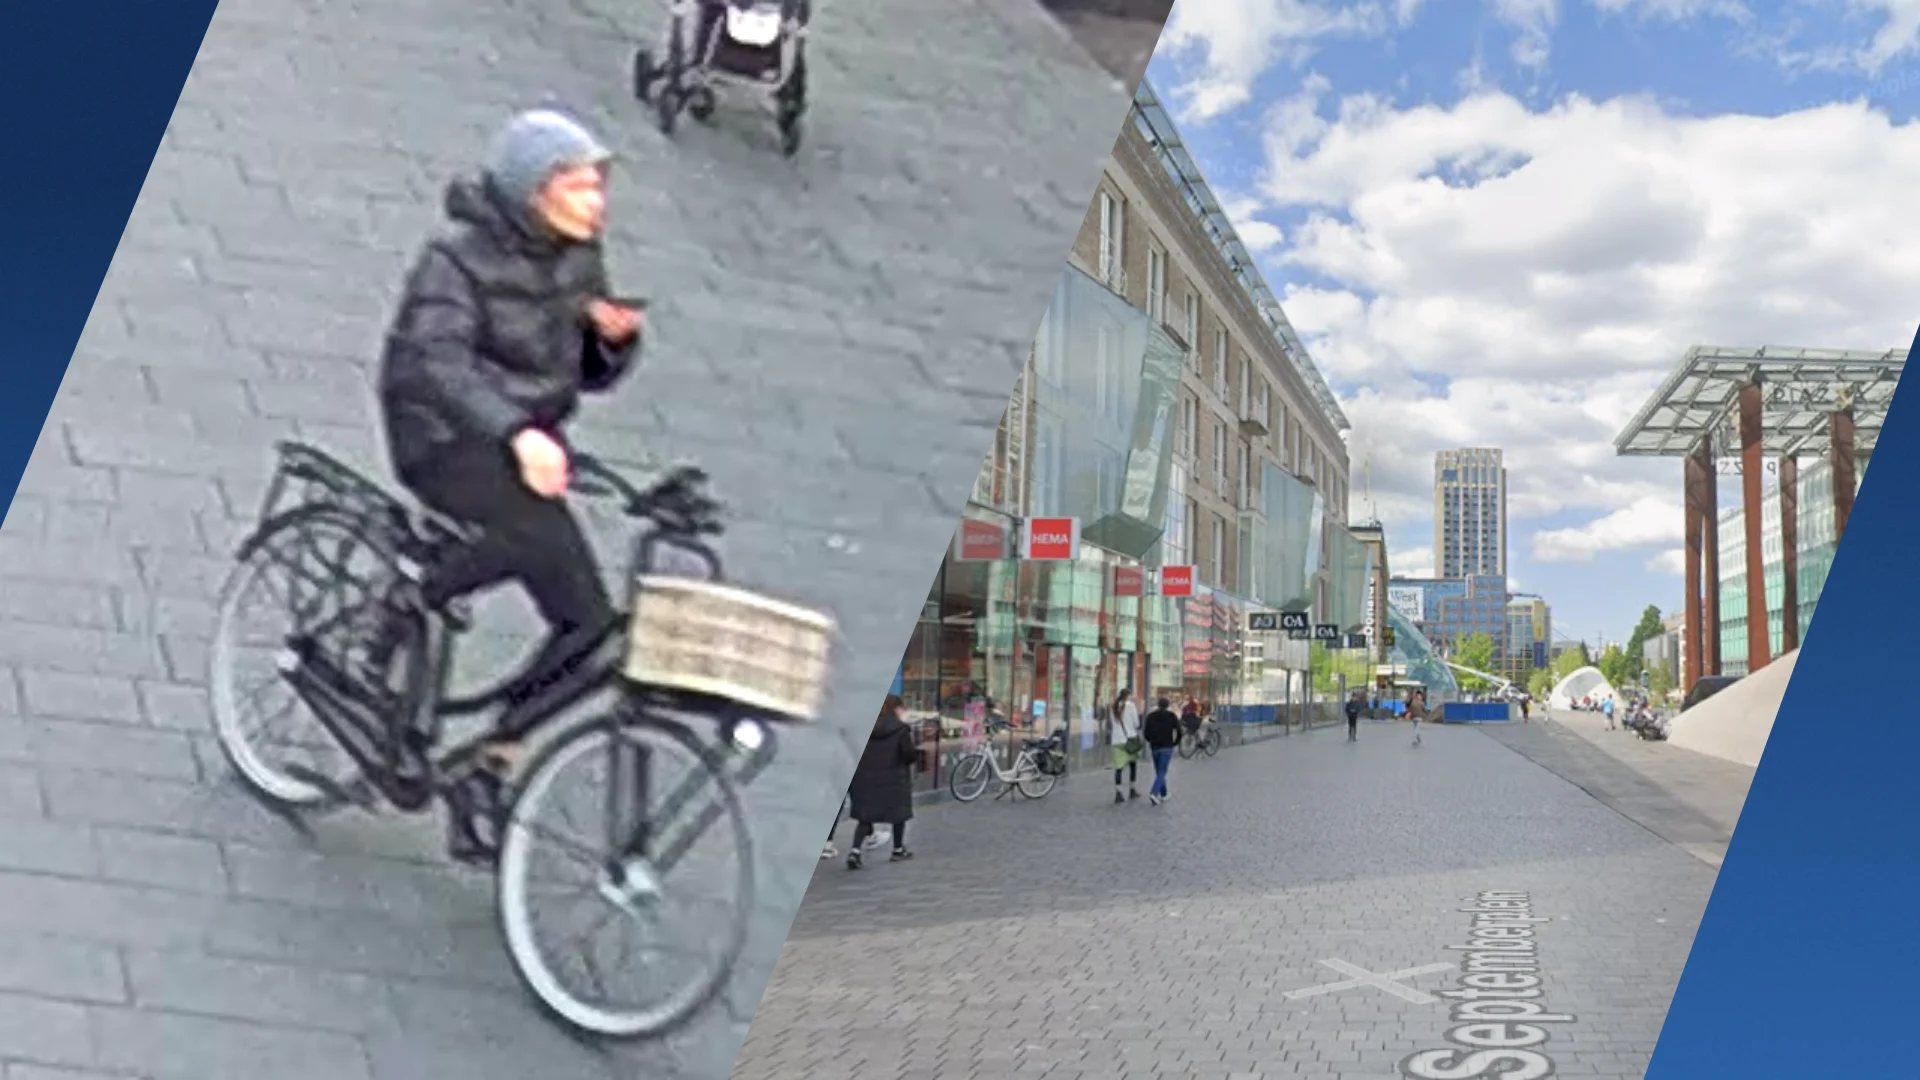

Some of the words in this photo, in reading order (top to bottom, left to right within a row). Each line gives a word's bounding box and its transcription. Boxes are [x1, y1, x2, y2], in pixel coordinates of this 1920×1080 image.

[1032, 532, 1070, 545] HEMA
[1163, 576, 1190, 586] HEMA
[1390, 590, 1417, 602] West
